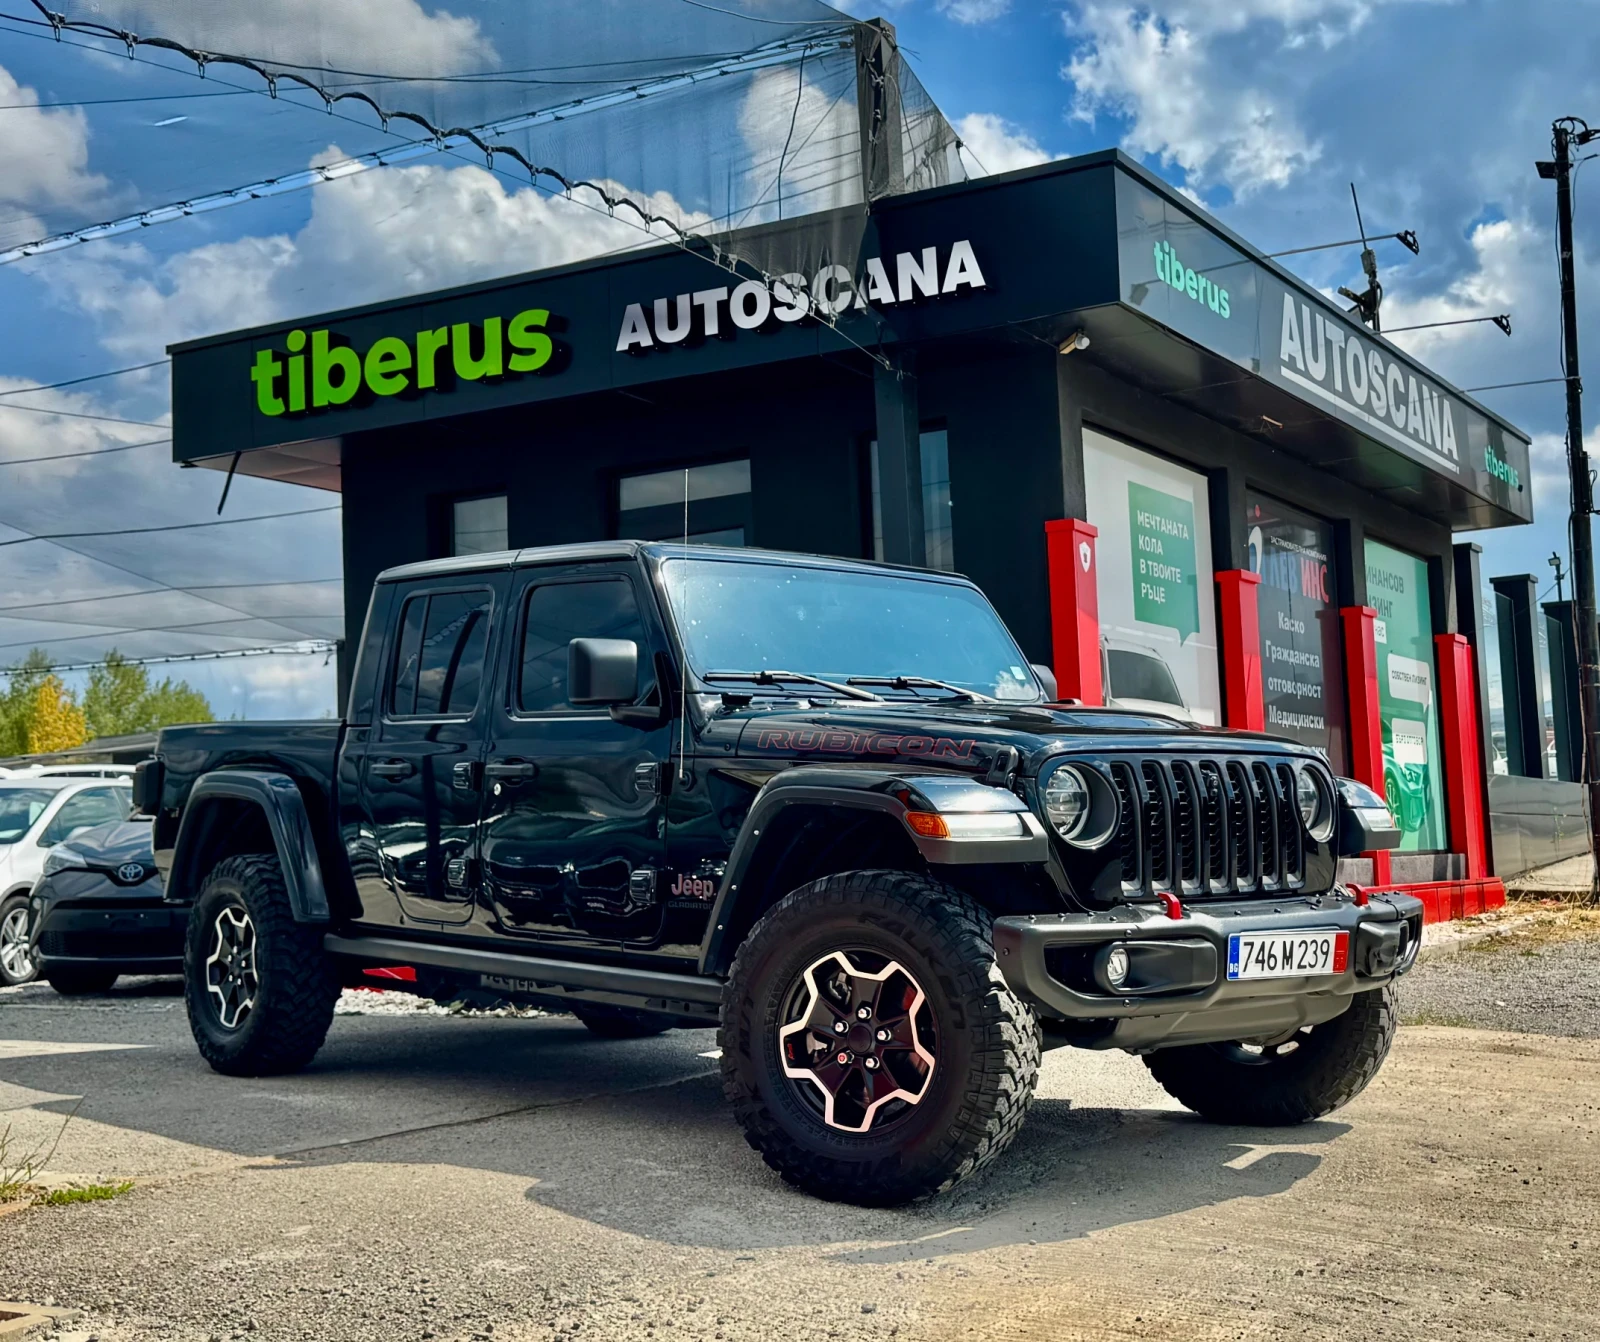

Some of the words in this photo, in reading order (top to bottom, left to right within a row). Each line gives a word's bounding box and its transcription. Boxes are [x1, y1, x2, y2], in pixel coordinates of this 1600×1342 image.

[1153, 240, 1231, 319] tiberus
[616, 239, 986, 351] AUTOSCANA
[251, 308, 552, 416] tiberus
[1280, 291, 1459, 462] AUTOSCANA
[1484, 444, 1519, 488] tiberus
[1136, 509, 1189, 540] МЕЧТАНАТА
[1138, 534, 1164, 556] КОЛА
[1140, 558, 1147, 574] В
[1147, 560, 1182, 583] ТВОИТЕ
[1300, 556, 1329, 603] ИНС
[1141, 583, 1166, 604] РЪЦЕ
[1277, 611, 1305, 634] Каско
[1265, 639, 1320, 668] Гражданска
[1267, 676, 1322, 699] отговорност
[1268, 704, 1325, 730] Медицински
[757, 729, 976, 759] RUBICON
[671, 873, 714, 901] Jeep
[1229, 963, 1239, 973] BG
